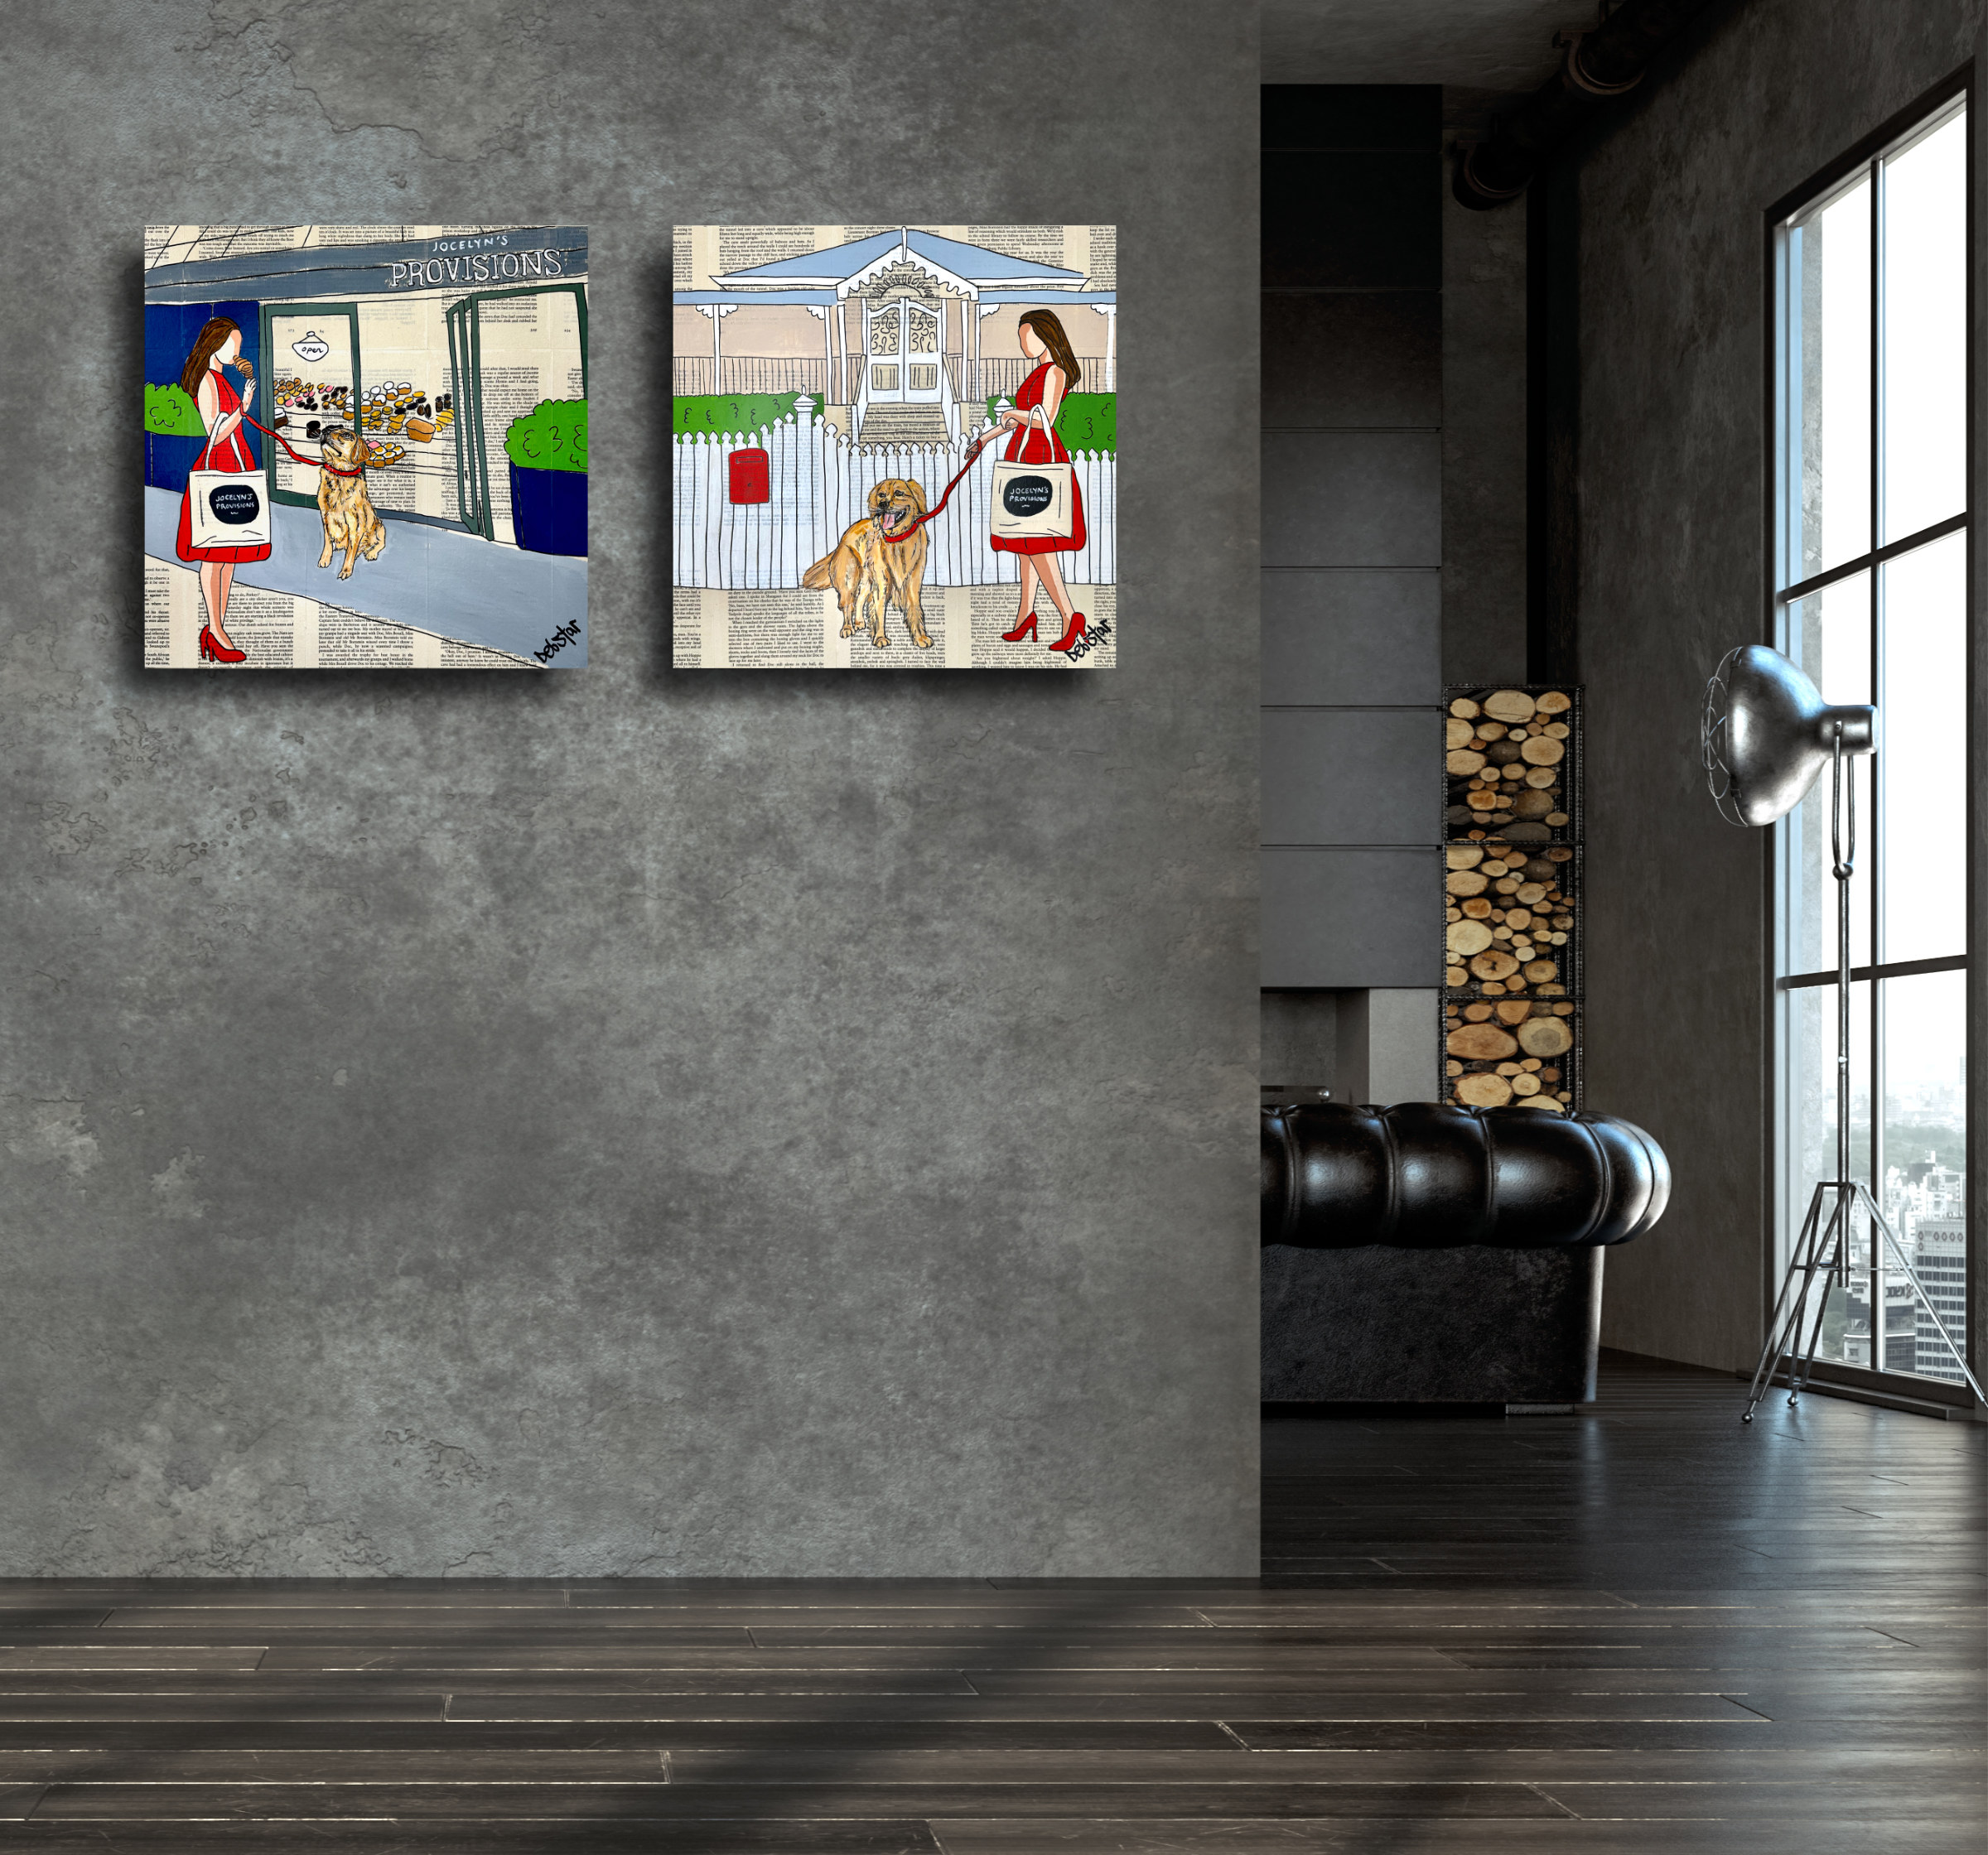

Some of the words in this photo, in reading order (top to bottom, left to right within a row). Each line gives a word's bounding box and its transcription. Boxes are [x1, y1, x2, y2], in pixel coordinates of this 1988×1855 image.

[432, 235, 509, 252] JOCELYN'S
[389, 248, 562, 287] PROVISIONS
[302, 346, 323, 354] open
[1010, 486, 1049, 495] JOCELYN'S
[215, 493, 253, 502] JOCELYN'S
[215, 502, 255, 510] PROVISIONS
